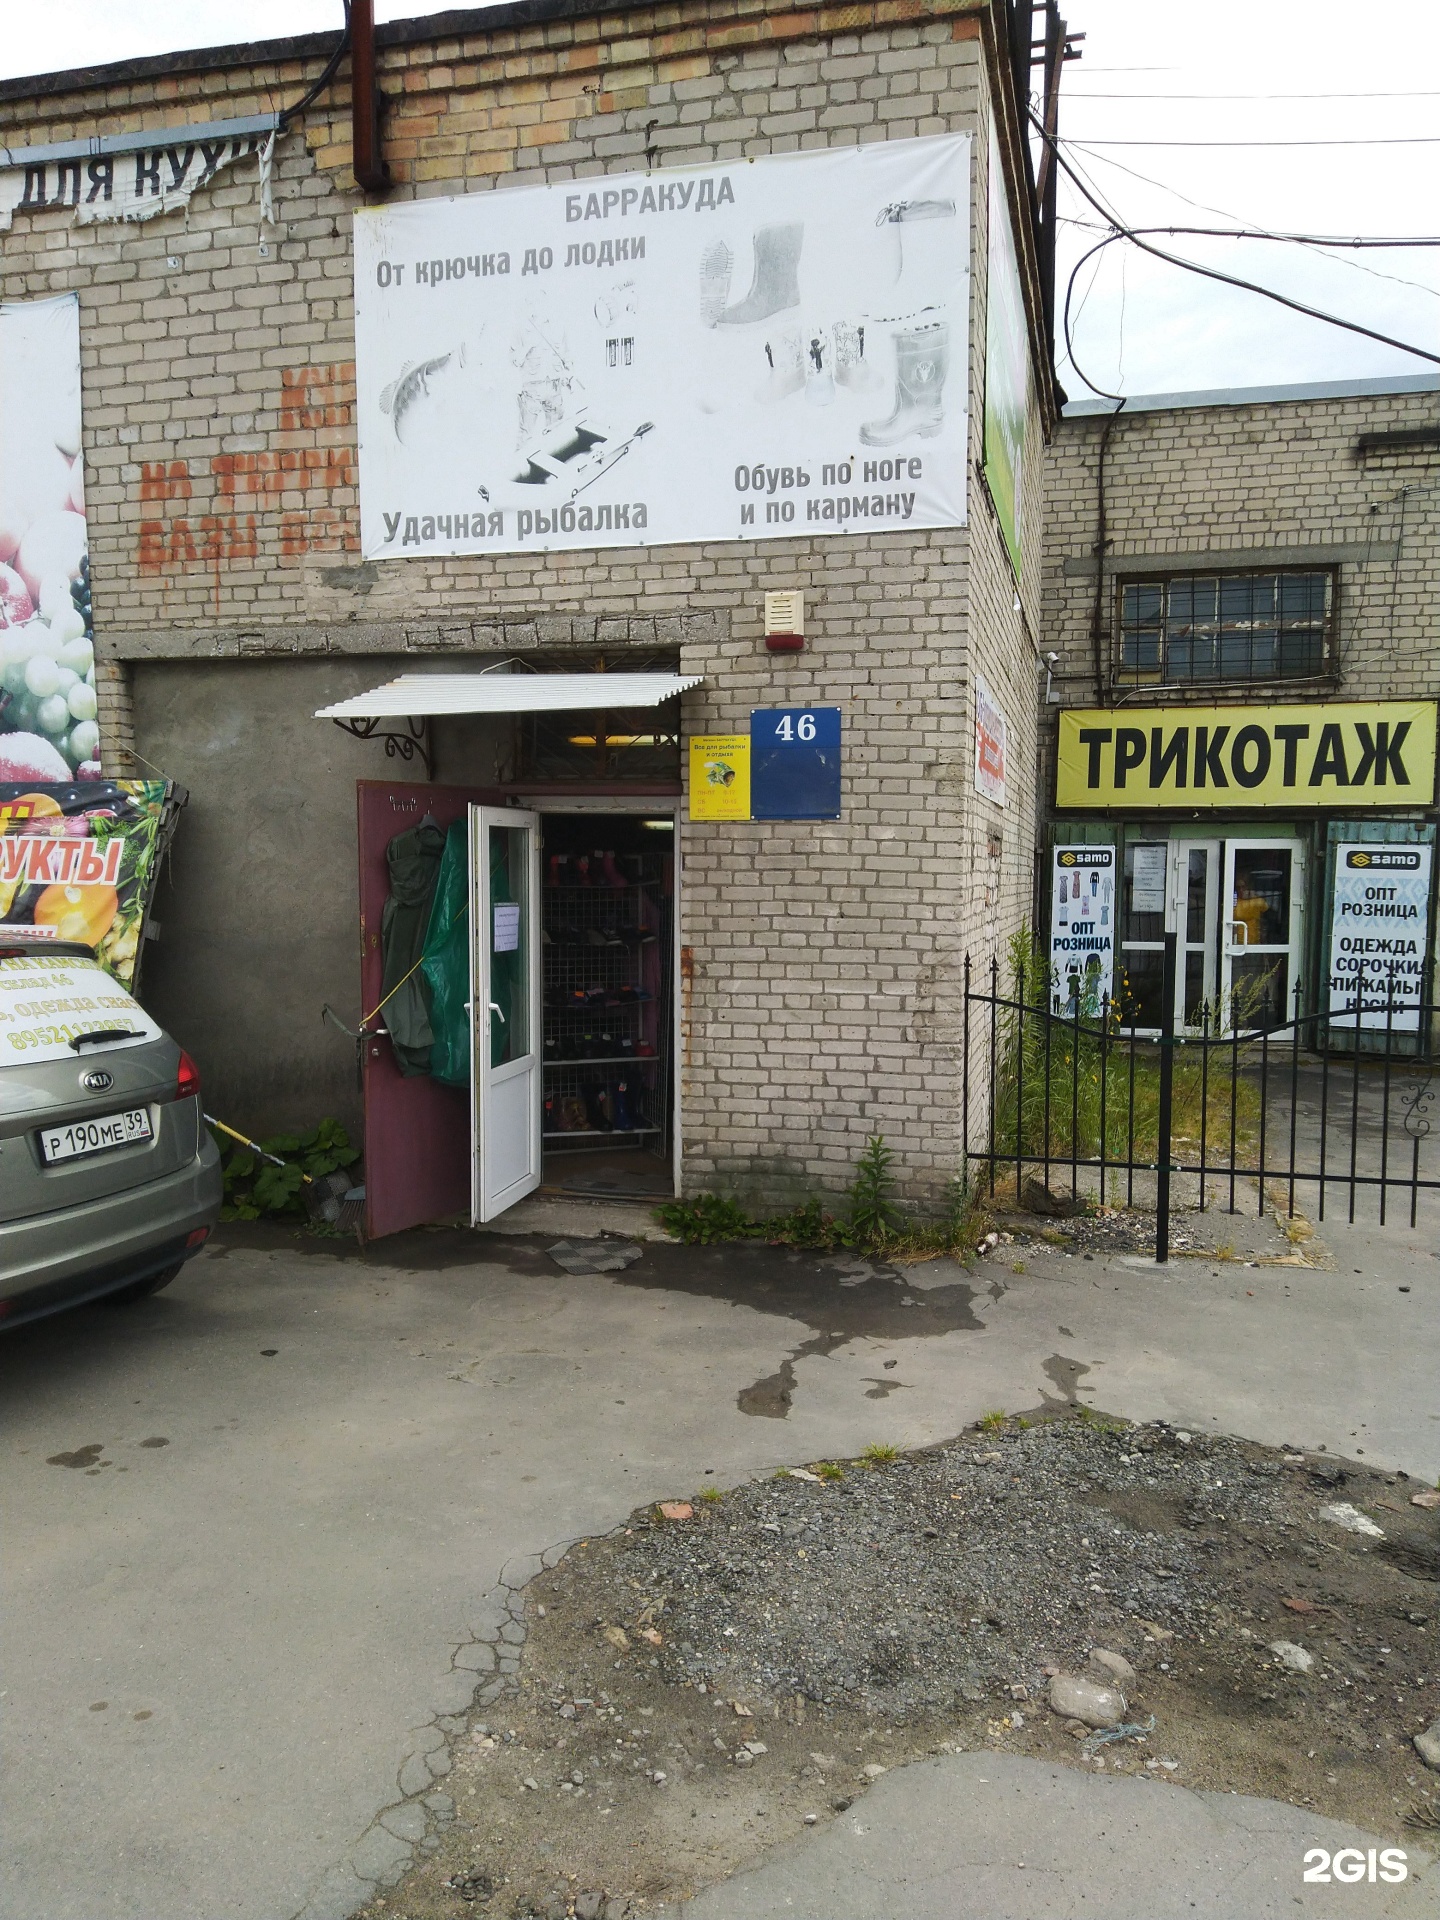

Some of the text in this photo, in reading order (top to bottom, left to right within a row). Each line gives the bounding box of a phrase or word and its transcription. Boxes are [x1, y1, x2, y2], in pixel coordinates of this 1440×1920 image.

[18, 157, 114, 208] ДЛЯ
[565, 177, 735, 223] БАРРАКУДА
[377, 236, 646, 287] От крючка до лодки
[734, 456, 923, 492] Обувь по ноге
[740, 489, 917, 525] и по карману
[383, 500, 648, 544] Удачная рыбалка
[775, 714, 817, 741] 46
[1079, 721, 1413, 789] ТРИКОТАЖ
[0, 837, 122, 884] УКТЫ
[1076, 853, 1110, 863] samo
[1371, 855, 1417, 865] samo
[1365, 887, 1397, 901] ОПТ
[1341, 903, 1418, 920] РОЗНИЦА
[1071, 921, 1095, 935] ОПТ
[1053, 936, 1111, 952] РОЗНИЦА
[1340, 937, 1418, 957] ОДЕЖДА
[1336, 957, 1420, 975] СОРОЧКИ
[51, 973, 75, 988] 46
[89, 1072, 110, 1088] KIA
[125, 1111, 143, 1131] 39
[127, 1130, 141, 1140] RUS
